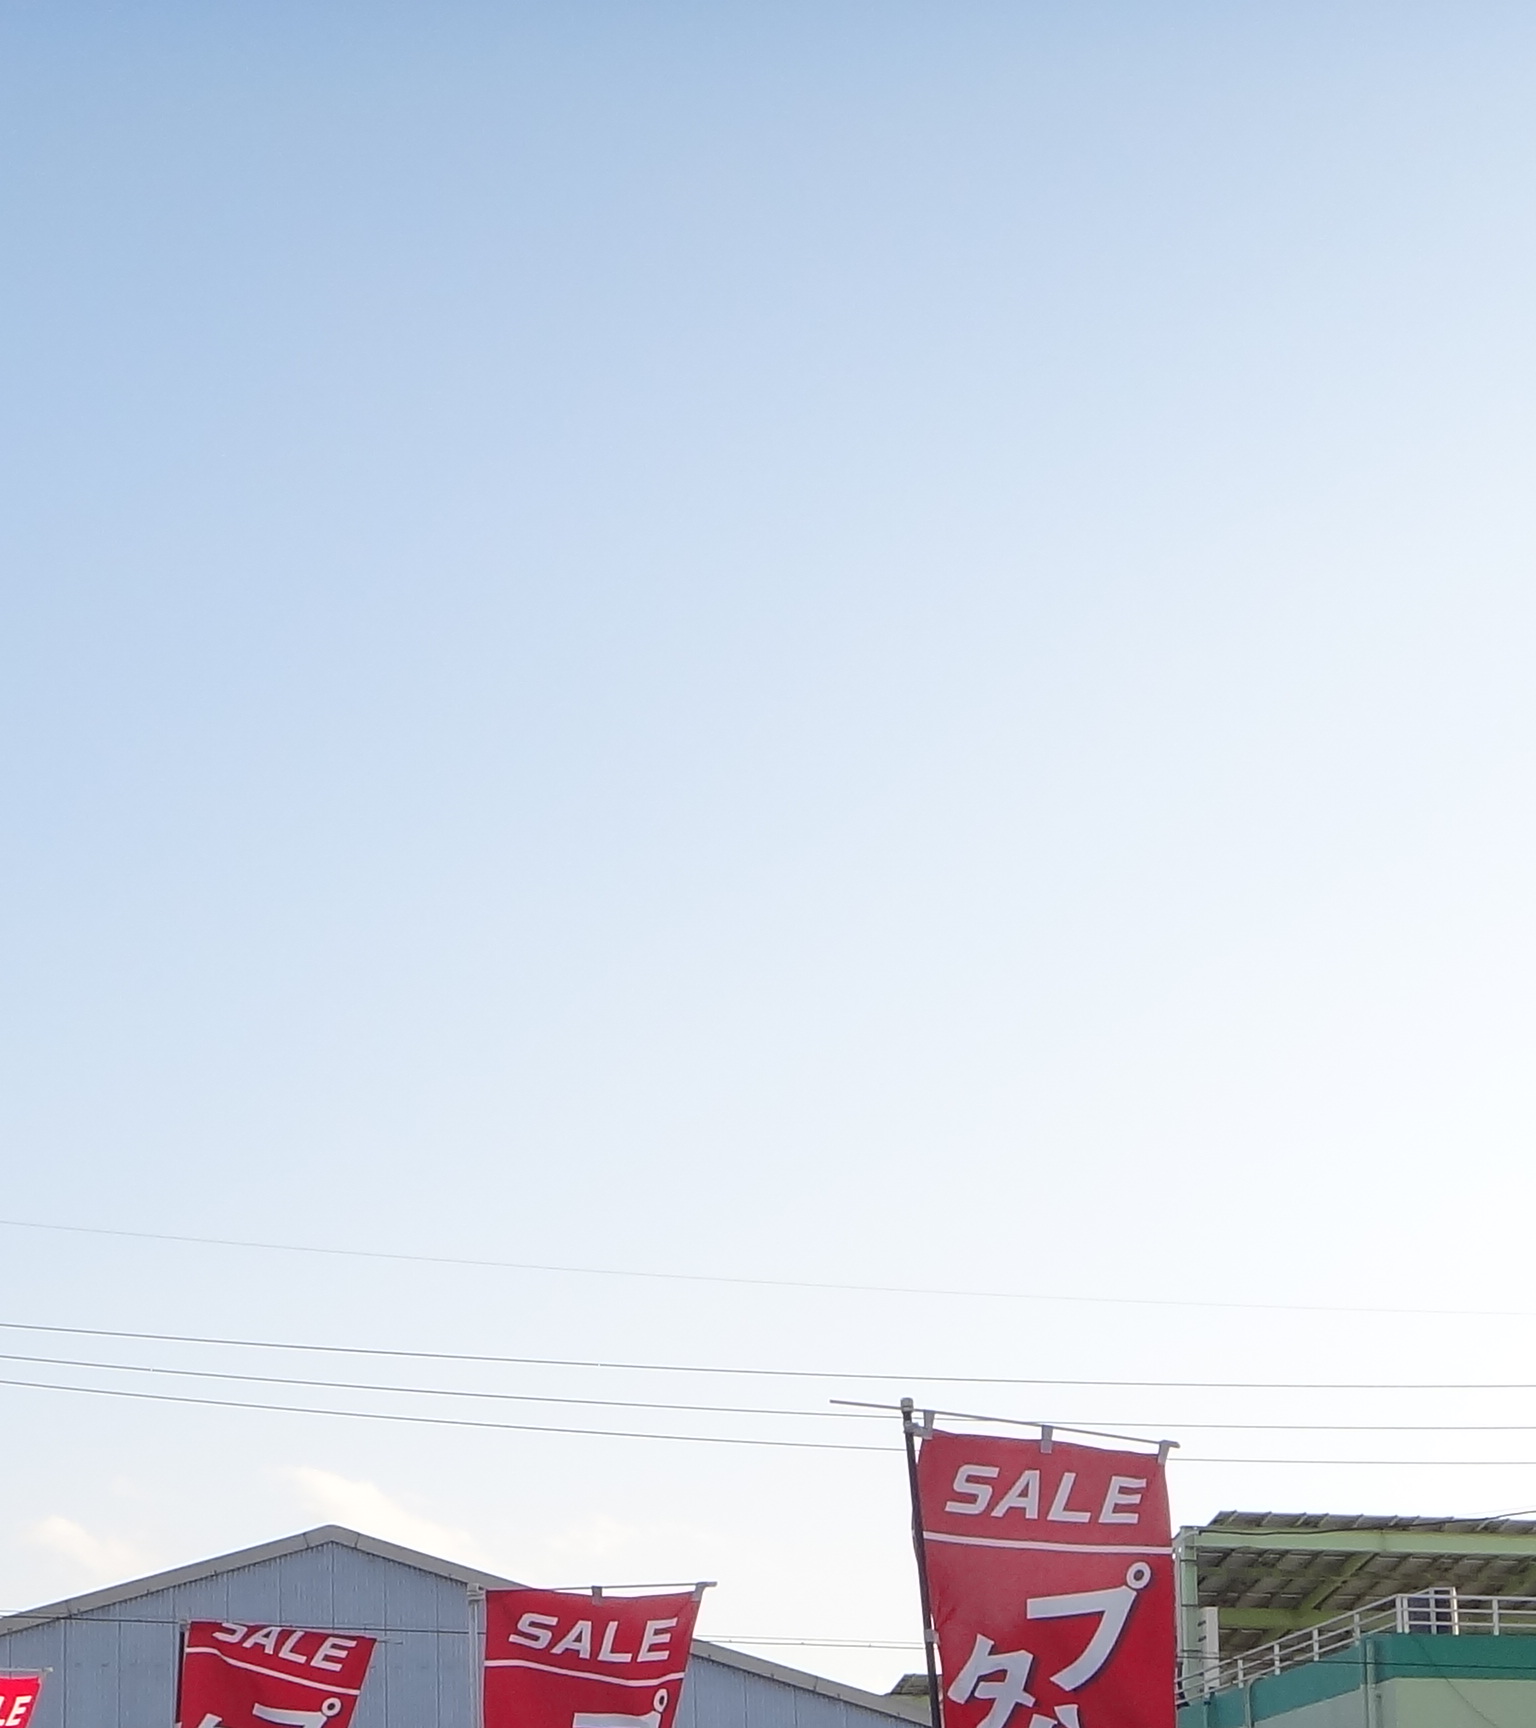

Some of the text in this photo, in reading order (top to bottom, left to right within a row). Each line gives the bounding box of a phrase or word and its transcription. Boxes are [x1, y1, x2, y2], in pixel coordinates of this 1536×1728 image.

[944, 1465, 1147, 1525] SALE
[212, 1622, 357, 1672] SALE
[509, 1613, 679, 1663] SALE
